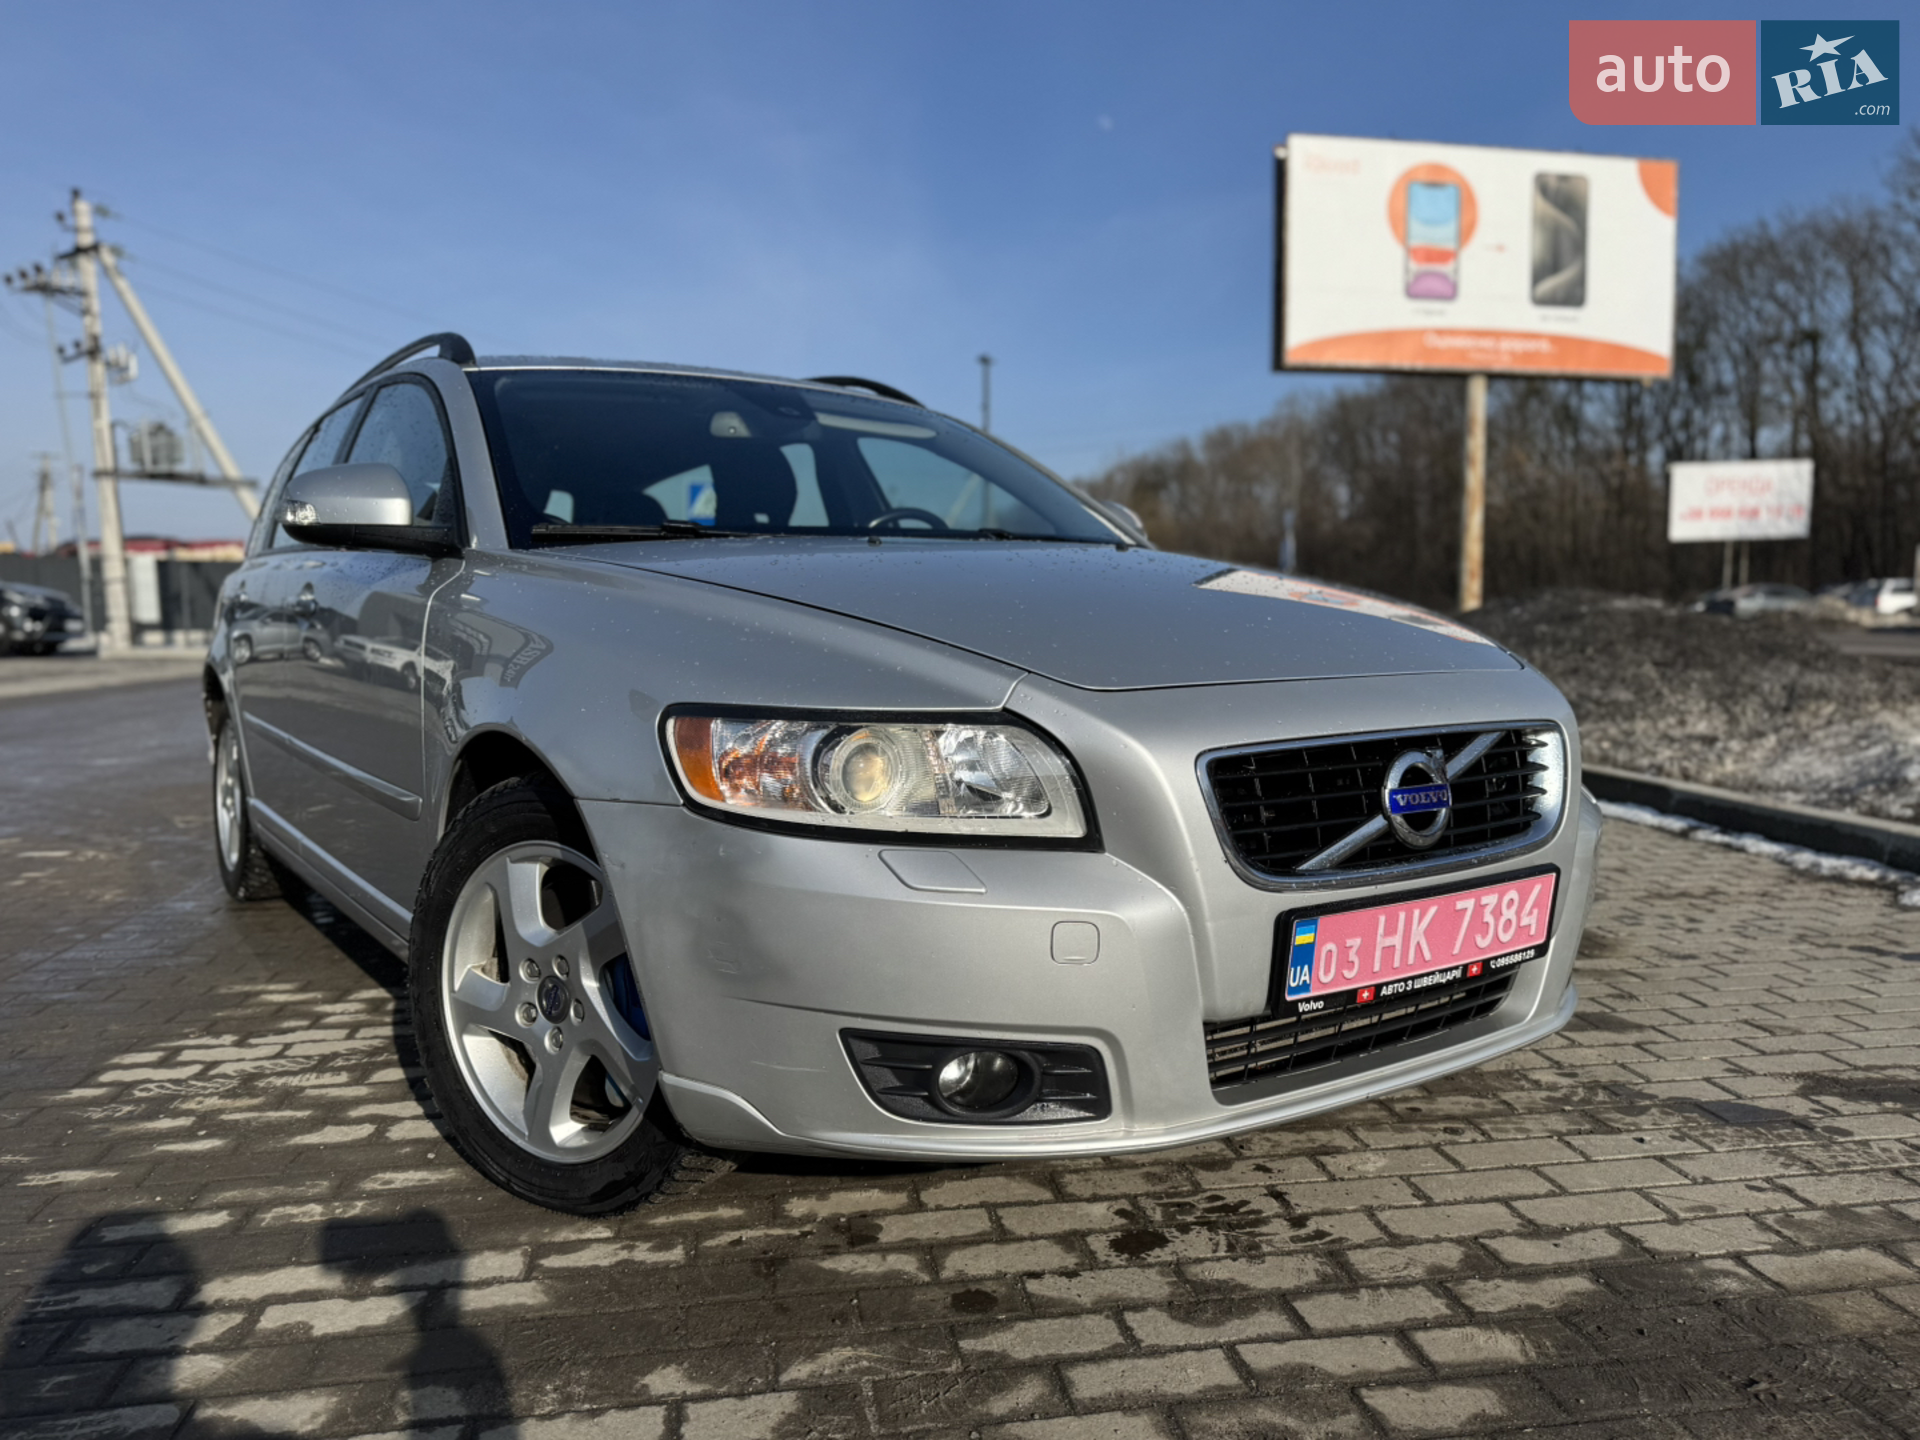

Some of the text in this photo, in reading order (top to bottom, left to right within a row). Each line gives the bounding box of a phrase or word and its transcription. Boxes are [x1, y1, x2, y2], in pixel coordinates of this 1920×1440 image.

[1392, 789, 1448, 806] VOLVO
[1318, 884, 1542, 984] 03 HK 7384
[1289, 964, 1310, 987] UA
[1380, 982, 1406, 997] АВТО
[1413, 966, 1463, 989] ШВЕЙЦАРІЇ
[1298, 1000, 1324, 1012] Volvo
